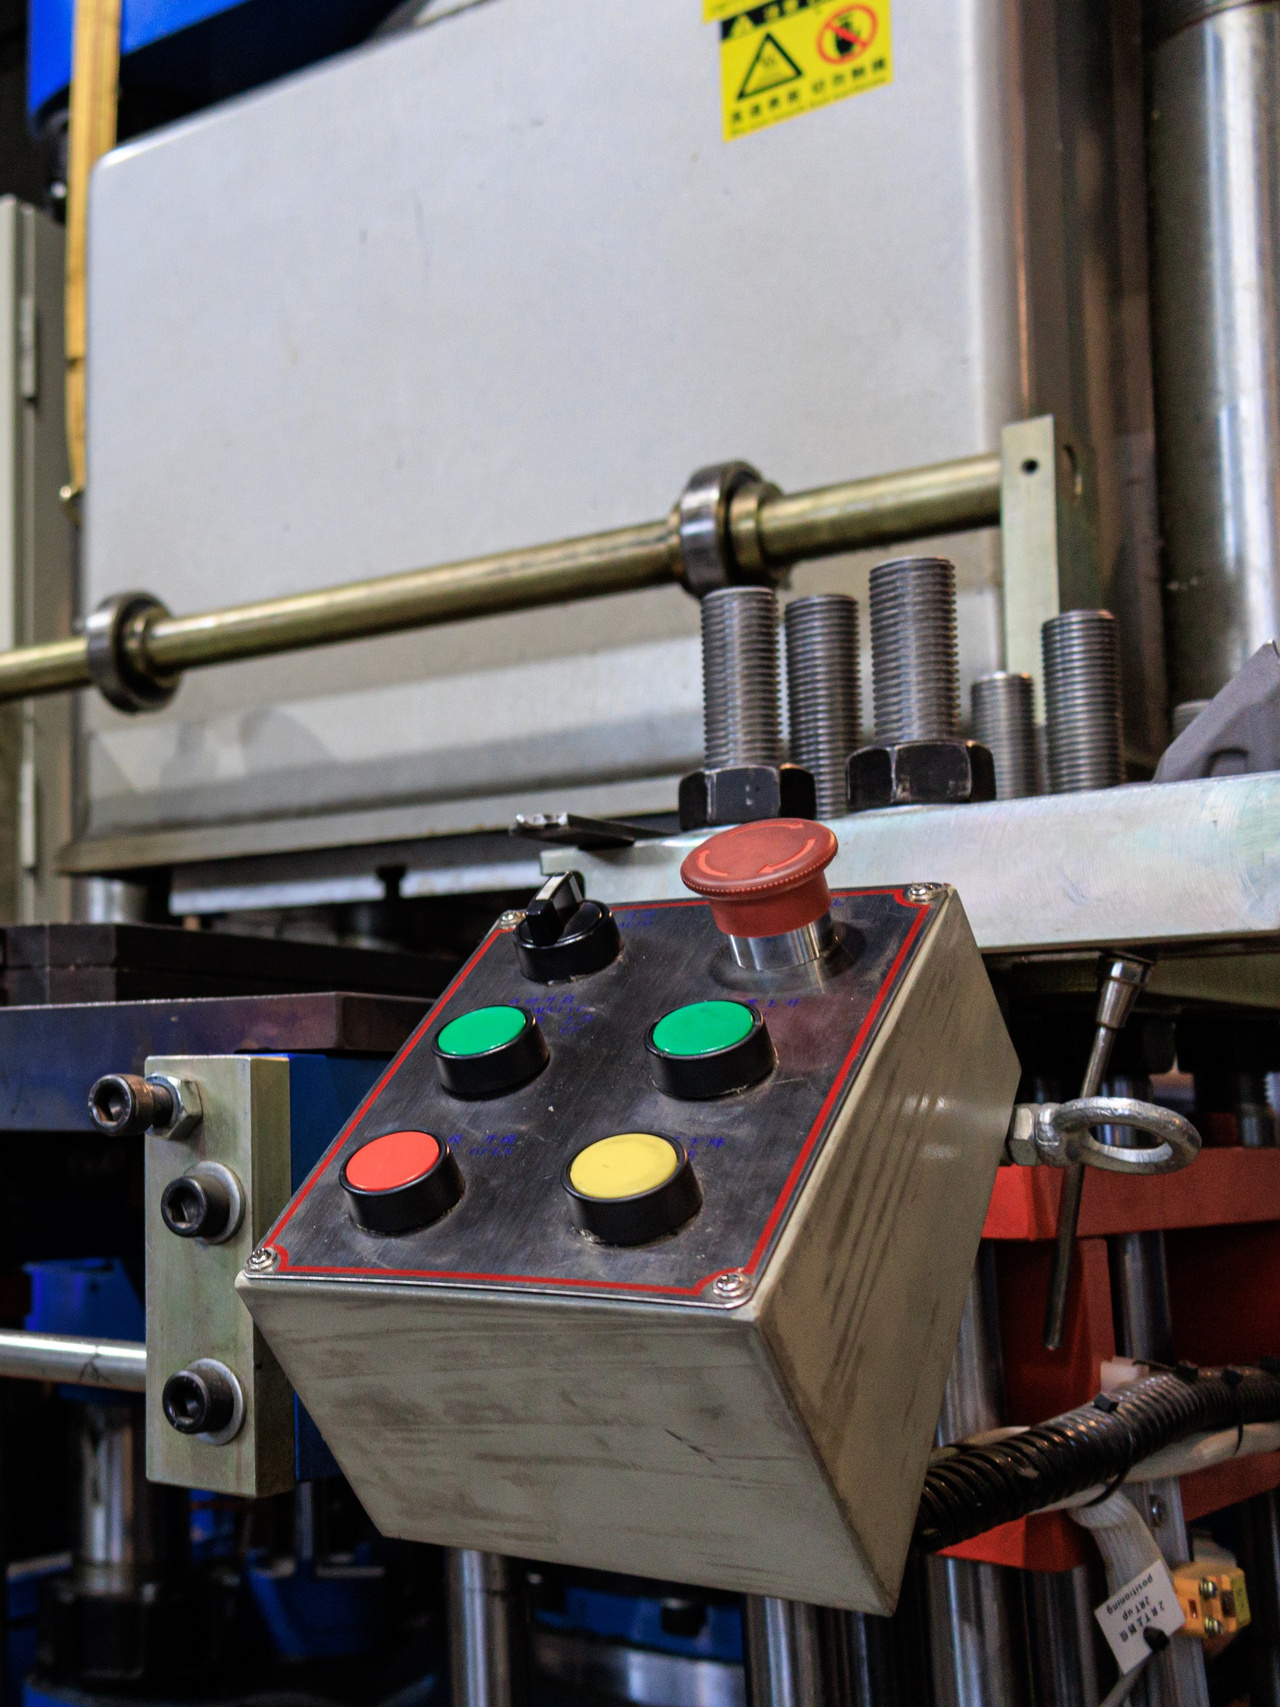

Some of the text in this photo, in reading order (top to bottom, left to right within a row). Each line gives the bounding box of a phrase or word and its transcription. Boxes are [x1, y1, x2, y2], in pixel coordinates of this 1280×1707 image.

[469, 1146, 514, 1157] OPEN
[1106, 1573, 1153, 1615] positioning
[1122, 1609, 1134, 1621] up
